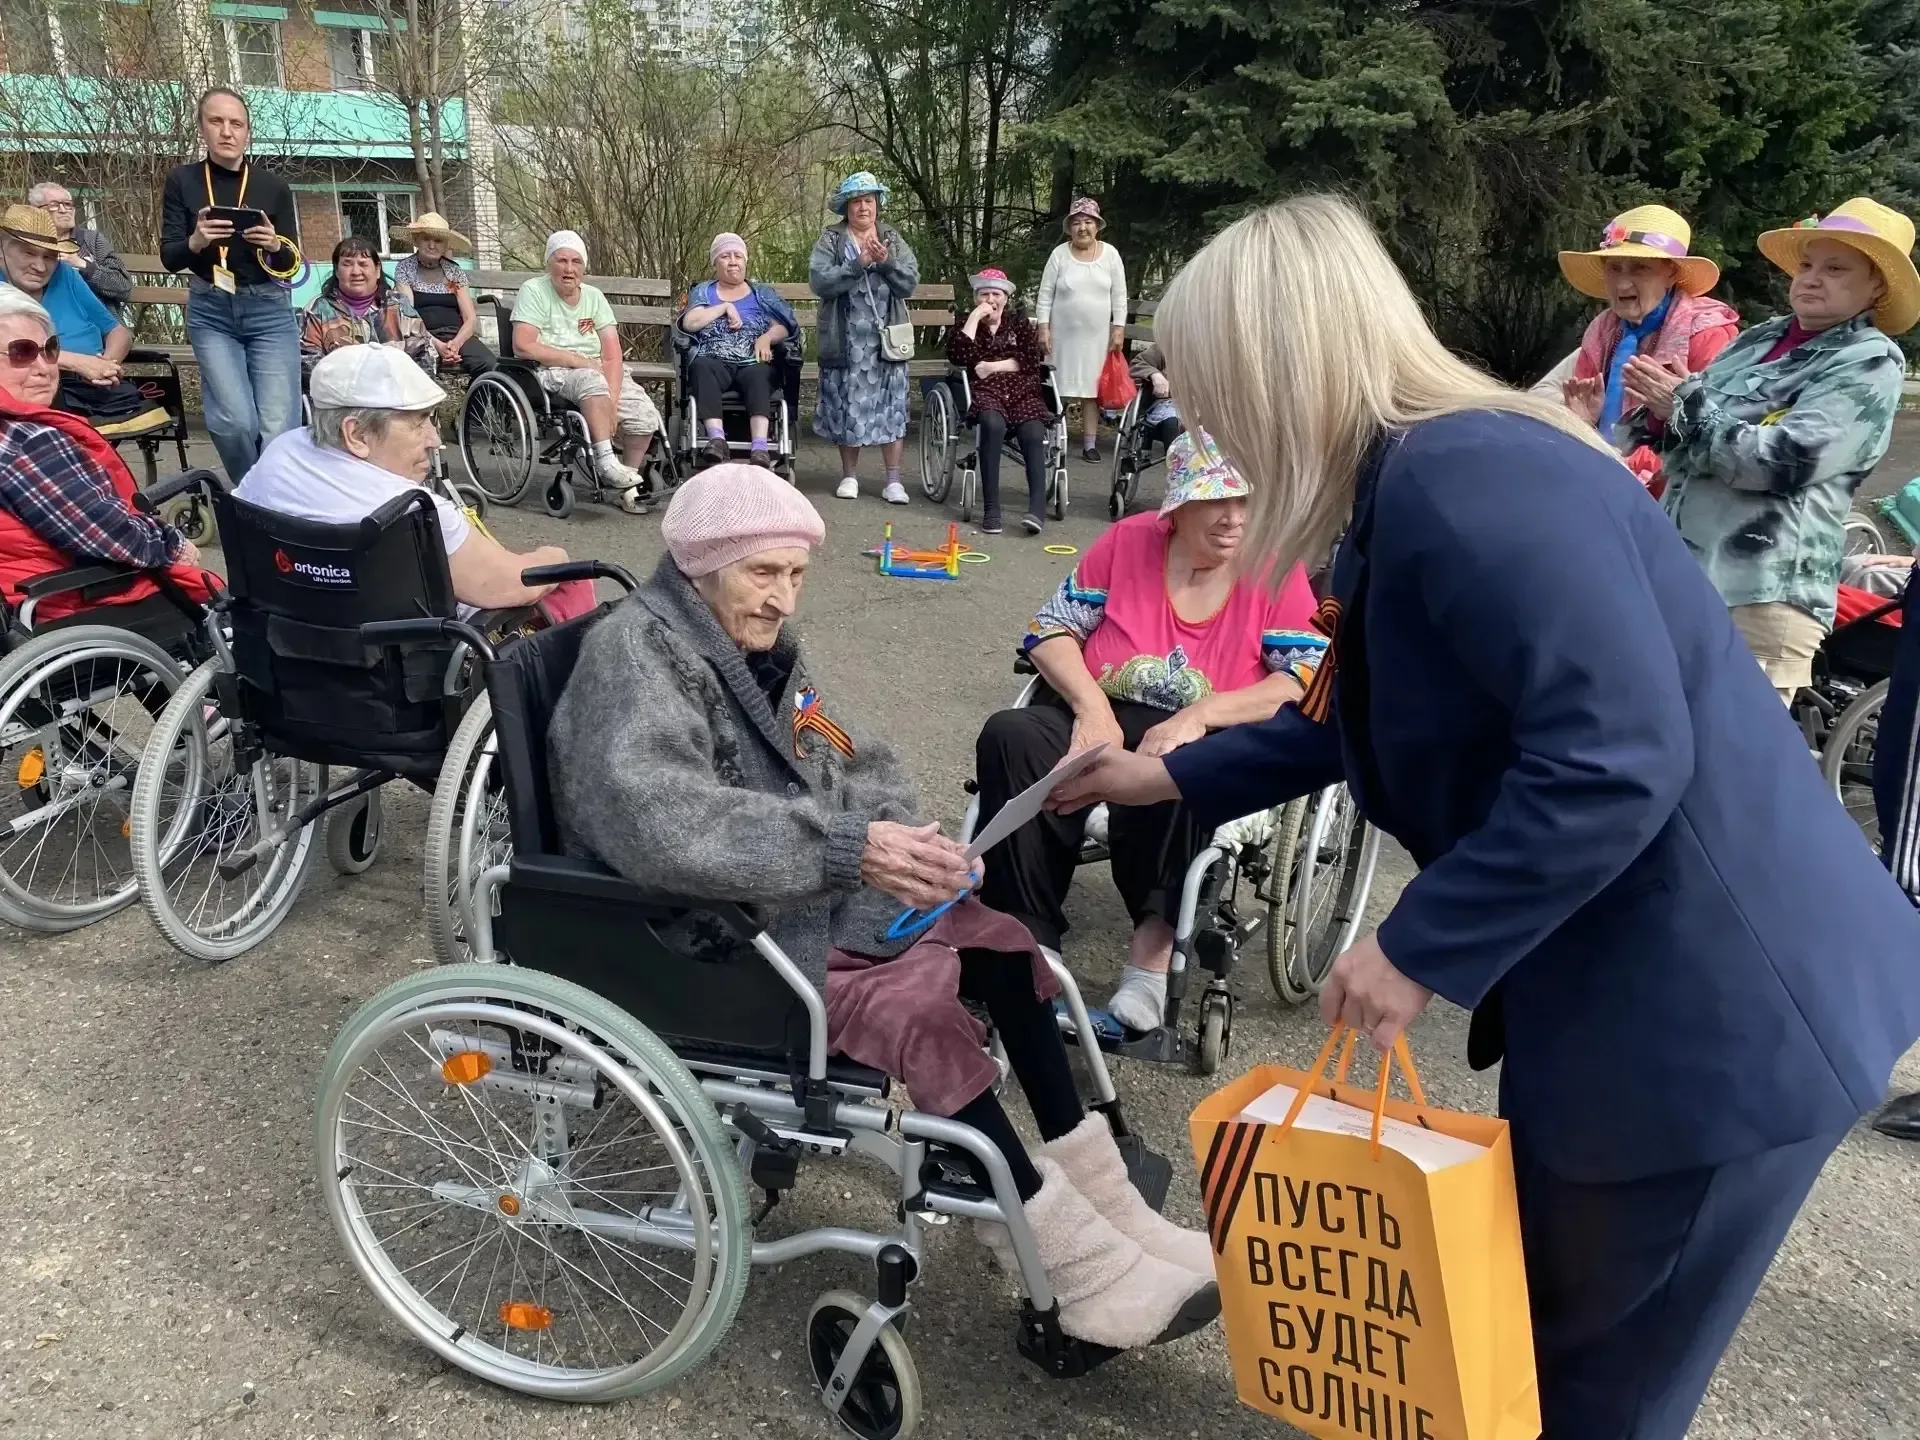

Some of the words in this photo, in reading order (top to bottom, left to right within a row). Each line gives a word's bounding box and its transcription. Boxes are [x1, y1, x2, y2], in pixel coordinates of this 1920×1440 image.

[294, 562, 350, 577] ortonica
[1254, 1171, 1402, 1250] ПУСТЬ
[1246, 1235, 1422, 1327] ВСЕГДА
[1268, 1301, 1411, 1386] БУДЕТ
